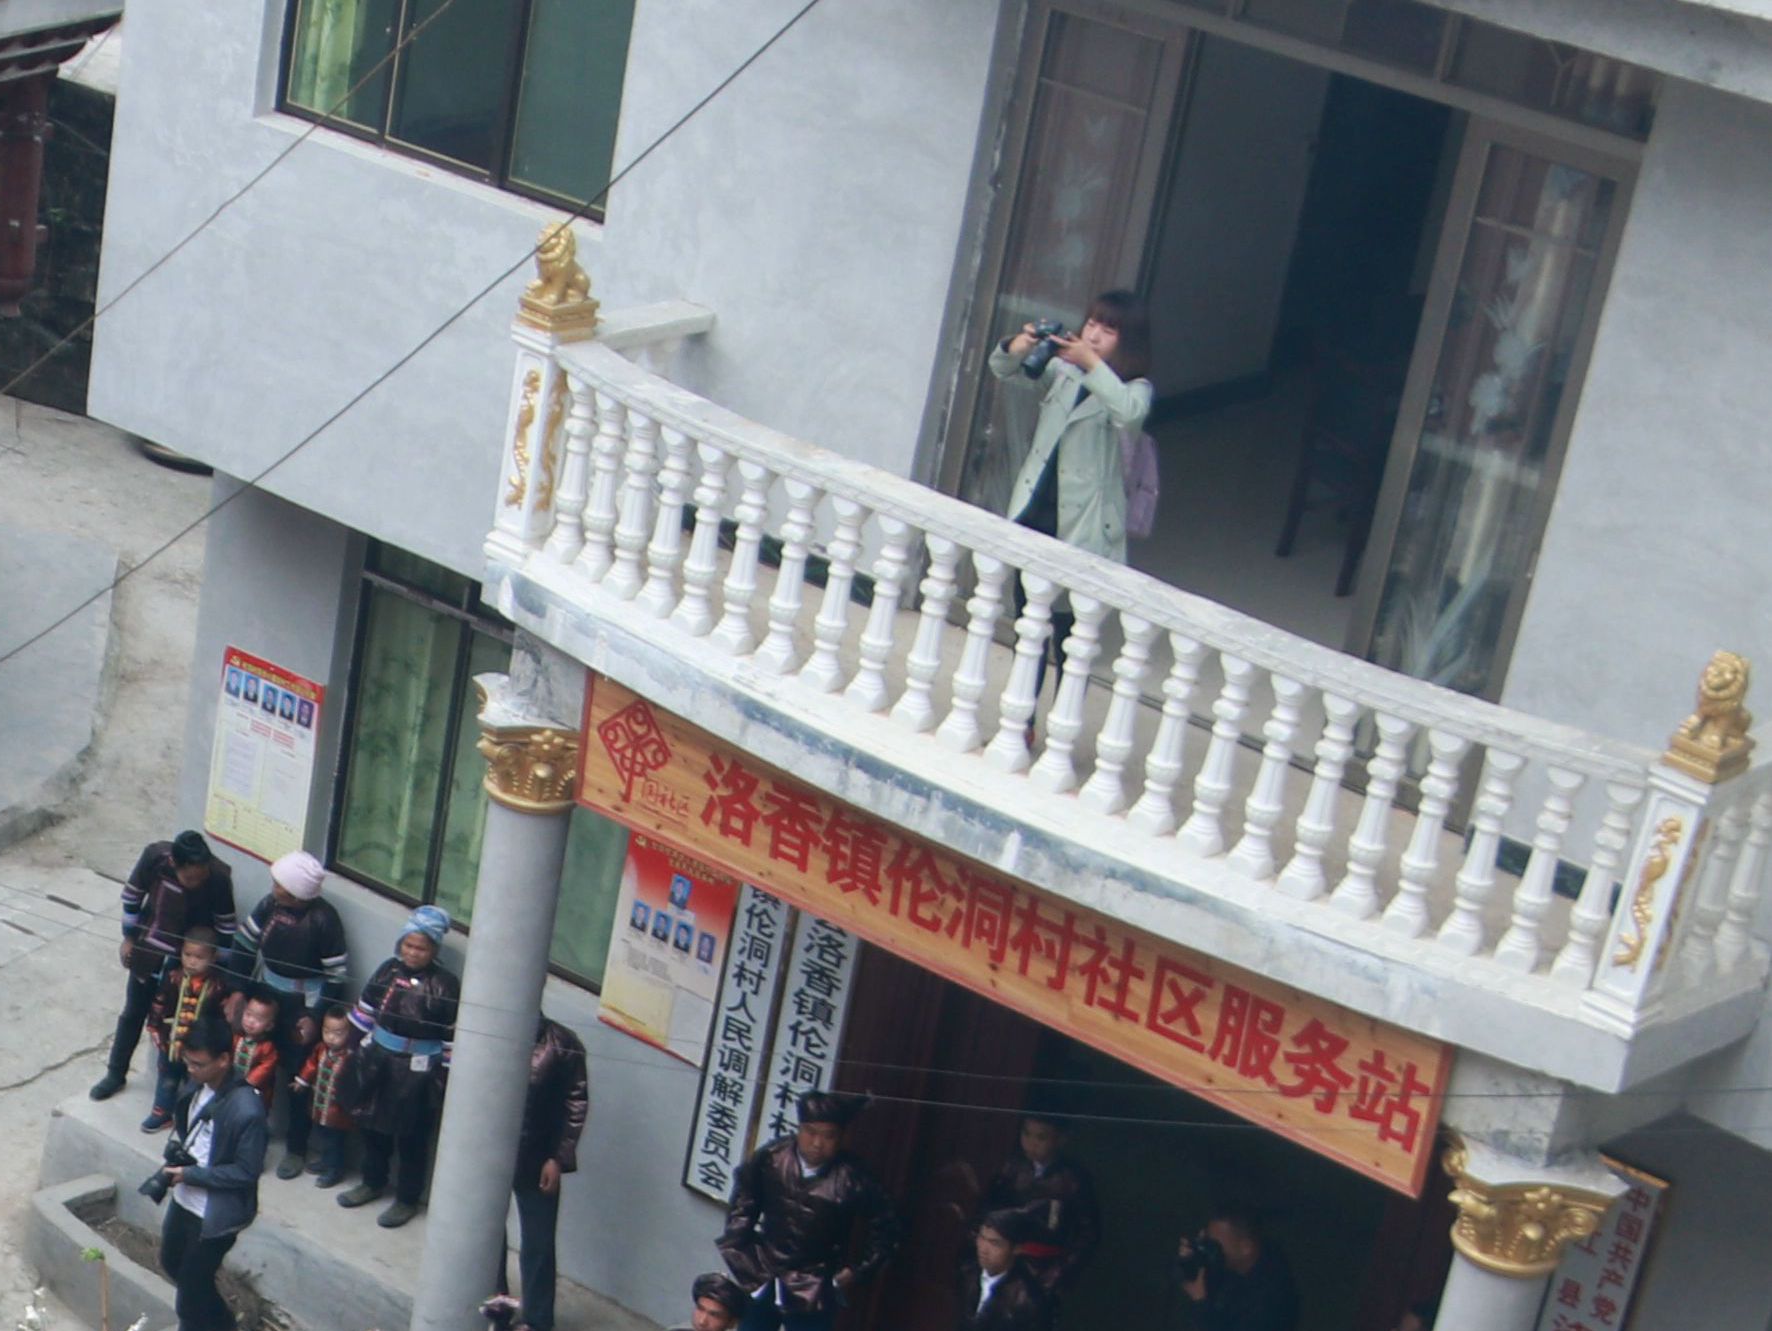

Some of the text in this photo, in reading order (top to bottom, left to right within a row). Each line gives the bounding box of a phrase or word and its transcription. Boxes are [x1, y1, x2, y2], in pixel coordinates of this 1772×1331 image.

[699, 751, 1435, 1155] 洛香镇伦洞村社区服务站
[1589, 1187, 1651, 1326] 中国共产党
